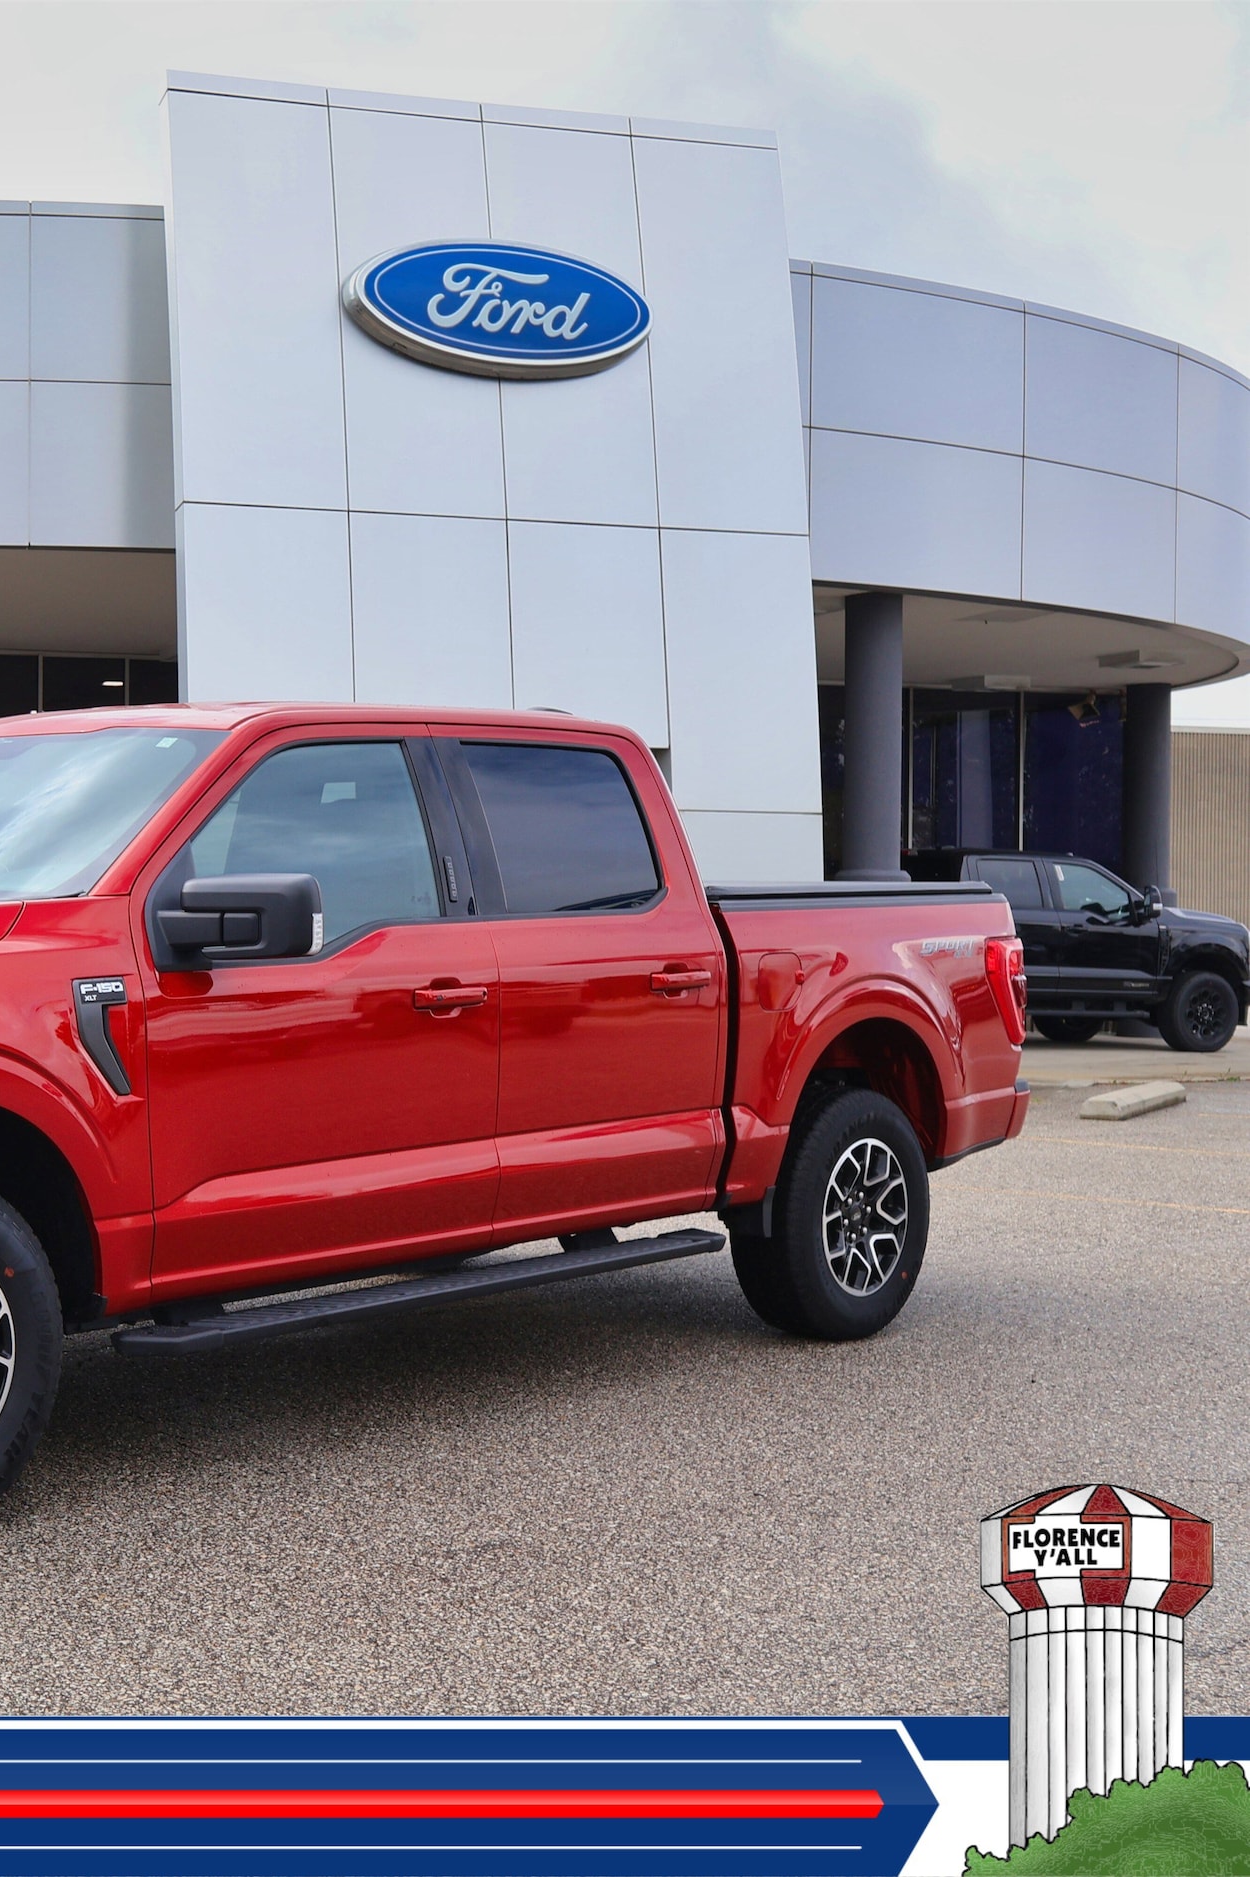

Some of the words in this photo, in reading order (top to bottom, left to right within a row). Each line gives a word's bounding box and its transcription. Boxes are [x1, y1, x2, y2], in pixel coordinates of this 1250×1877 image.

[427, 262, 591, 341] Ford
[919, 939, 975, 955] SPORT
[80, 981, 124, 994] F-150
[84, 994, 97, 1002] XLT
